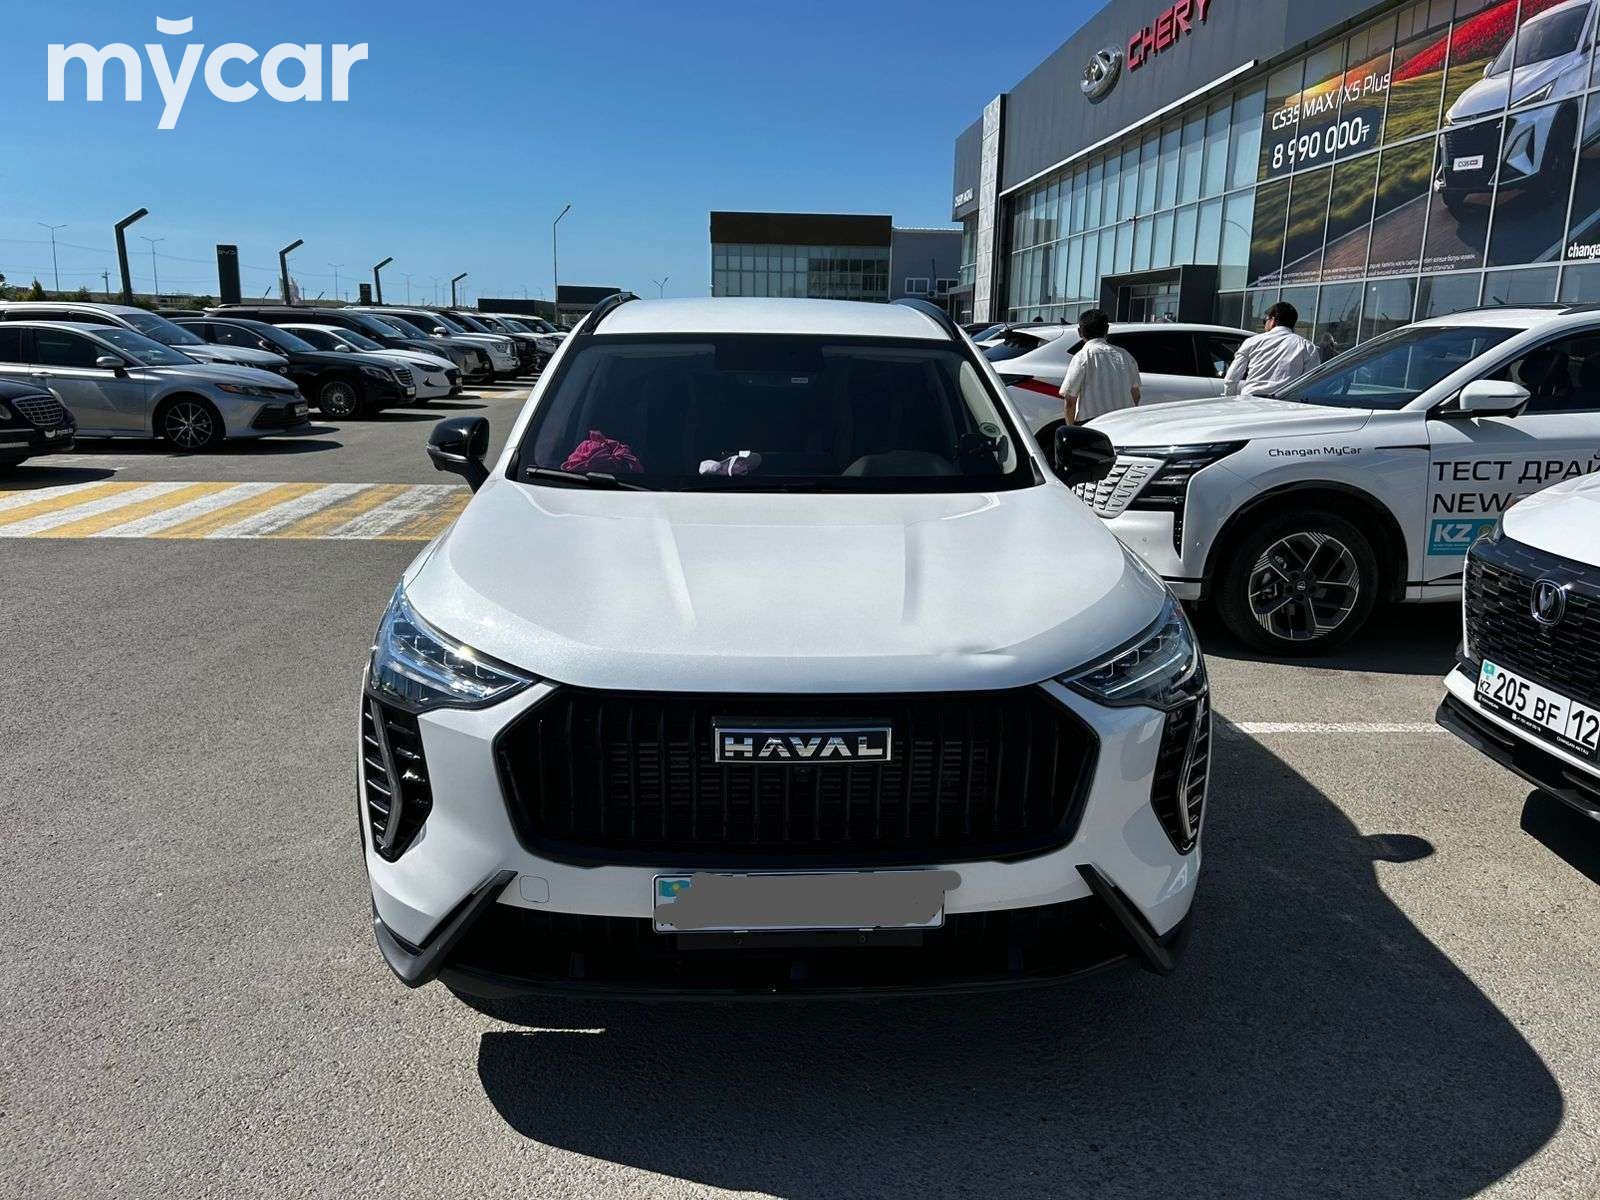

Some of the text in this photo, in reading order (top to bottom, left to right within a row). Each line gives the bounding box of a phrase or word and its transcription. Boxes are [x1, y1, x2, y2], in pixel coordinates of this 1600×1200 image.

[1127, 0, 1211, 72] CHERY
[1272, 104, 1300, 131] CS35
[1302, 90, 1335, 119] MAX
[1362, 72, 1391, 96] Plus
[1272, 143, 1284, 169] 8
[1287, 131, 1321, 164] 990
[1268, 446, 1362, 457] Changan MyCar
[1432, 460, 1512, 481] ТЕСТ
[1432, 493, 1512, 513] NEW
[1434, 523, 1473, 543] KZ
[1479, 678, 1491, 695] KZ
[1493, 672, 1530, 711] 205
[1533, 696, 1560, 726] BF
[1571, 709, 1600, 748] 12
[724, 736, 883, 757] HAVAL
